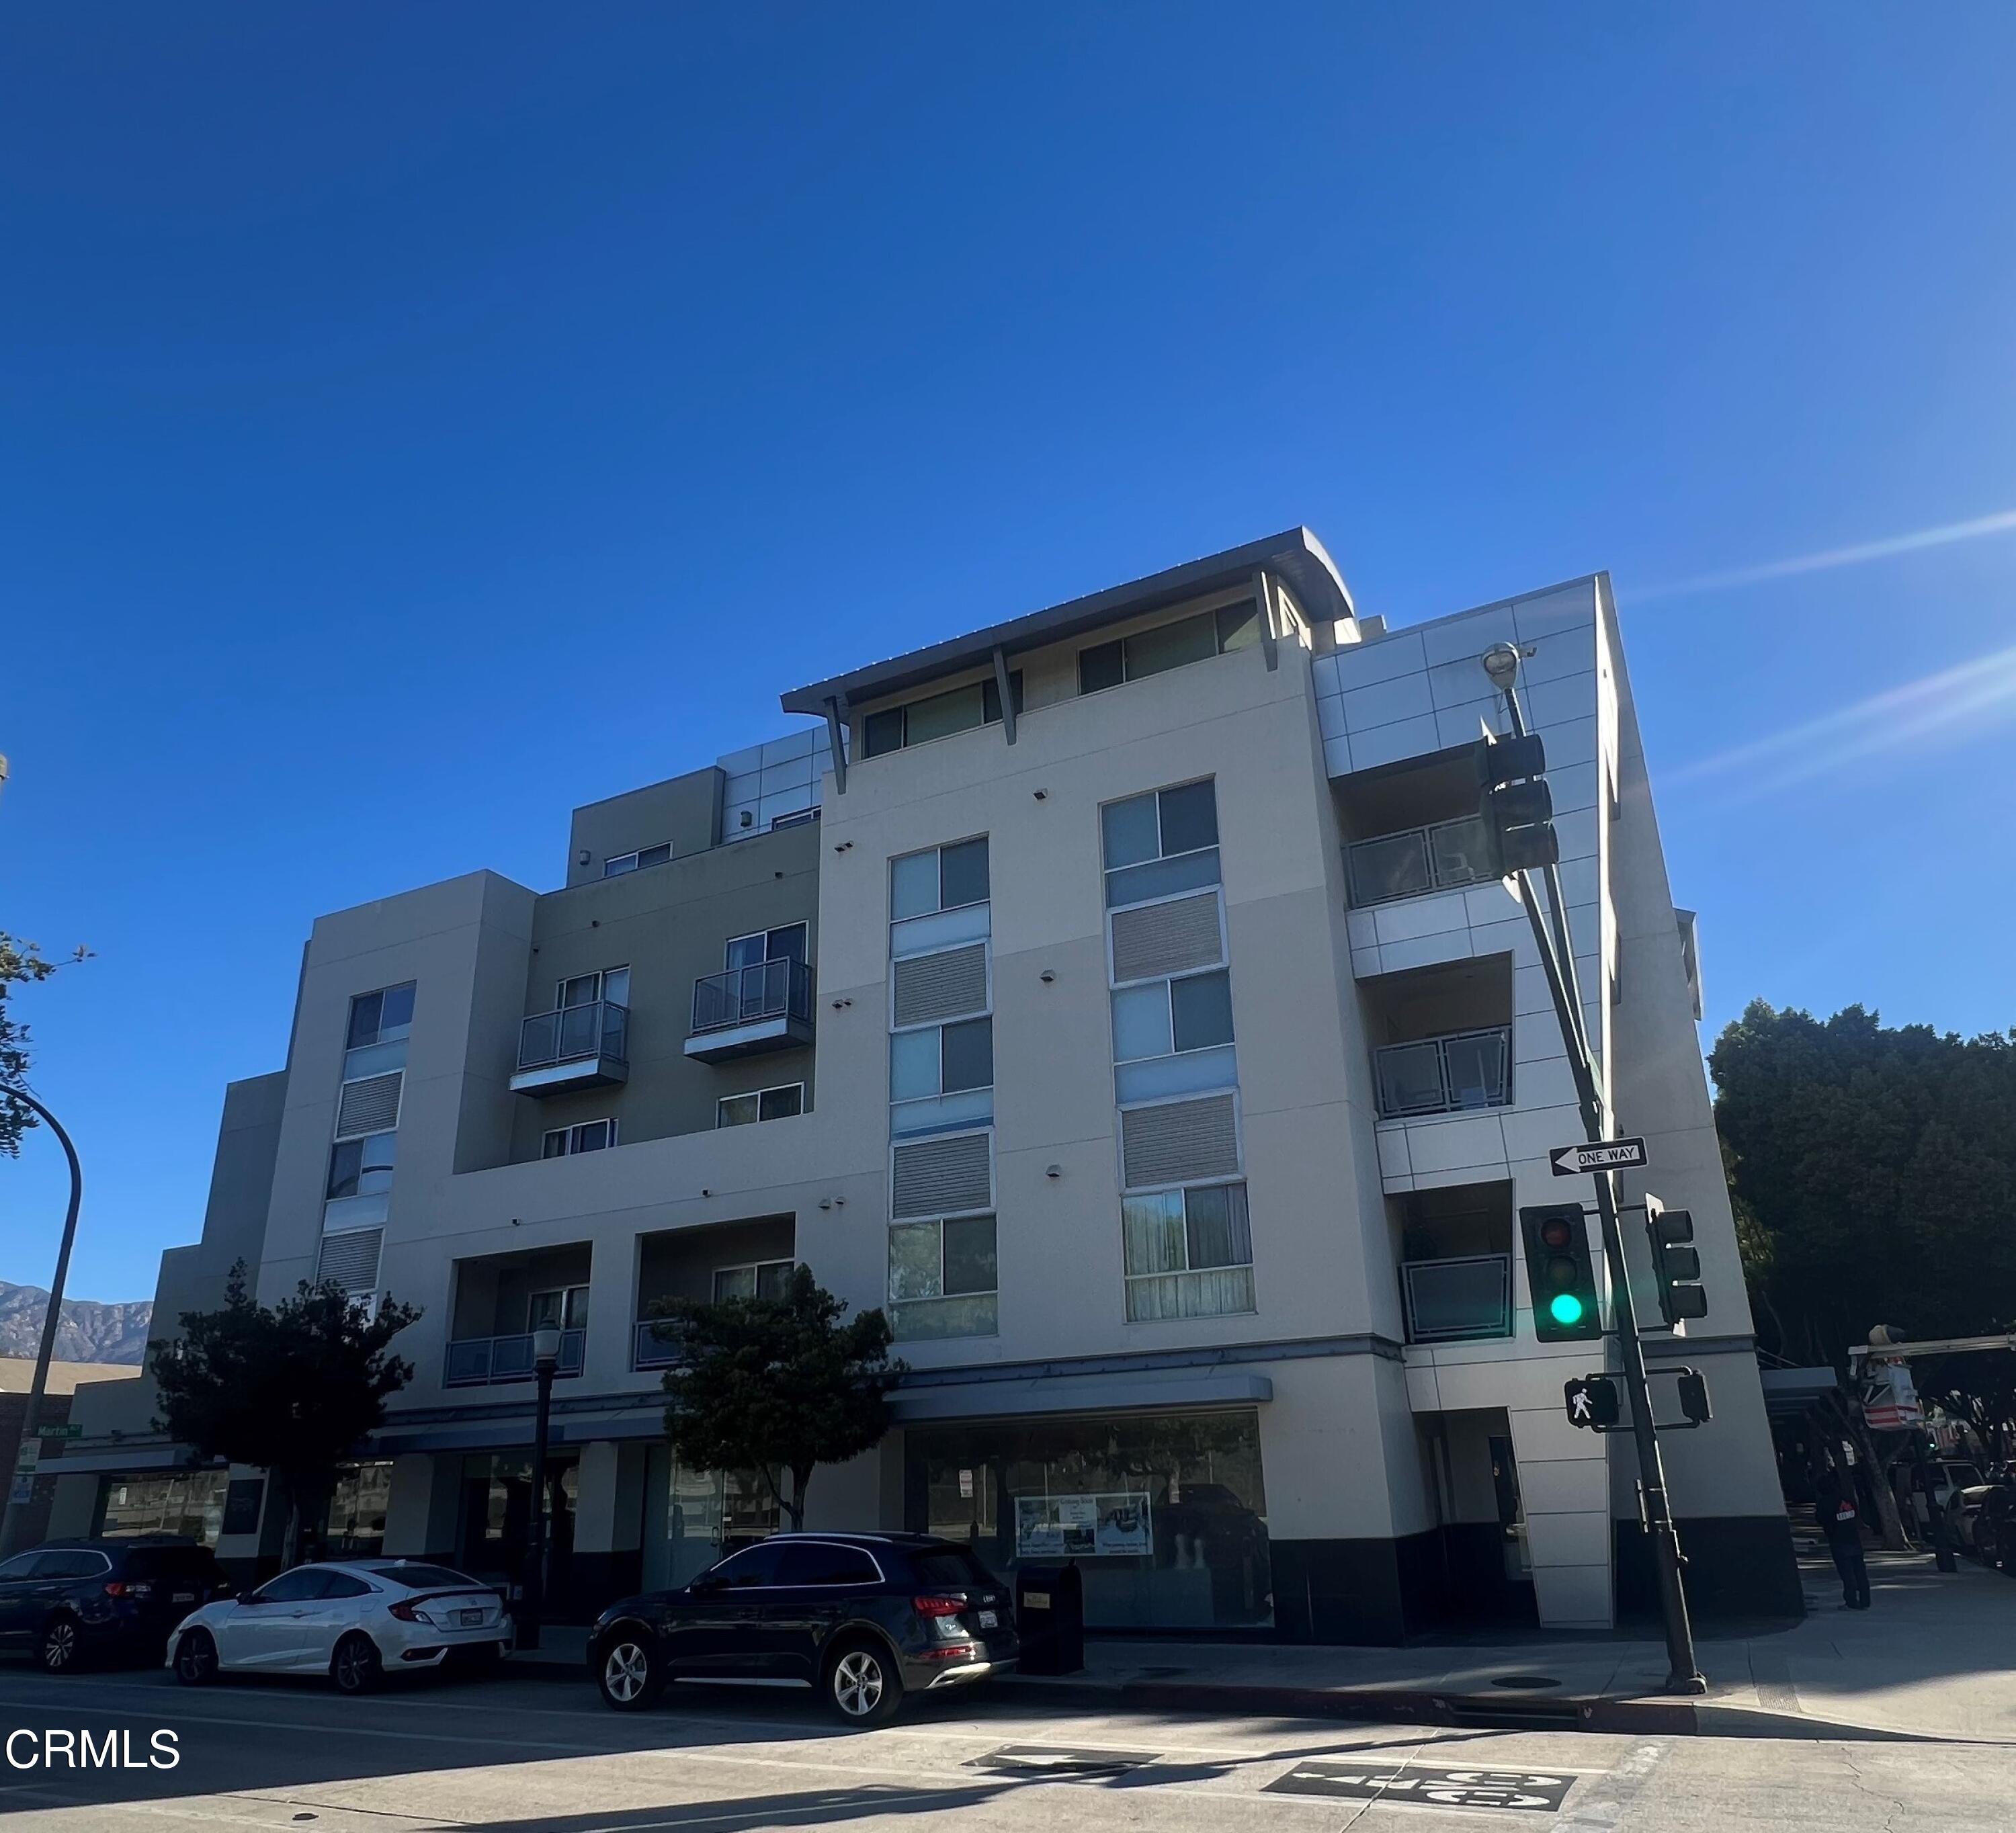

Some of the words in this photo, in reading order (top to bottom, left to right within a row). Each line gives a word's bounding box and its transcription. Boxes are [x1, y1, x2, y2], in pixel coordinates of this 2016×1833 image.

[1579, 1151, 1604, 1164] ONE
[1607, 1147, 1634, 1160] WAY
[38, 1425, 68, 1437] Martin
